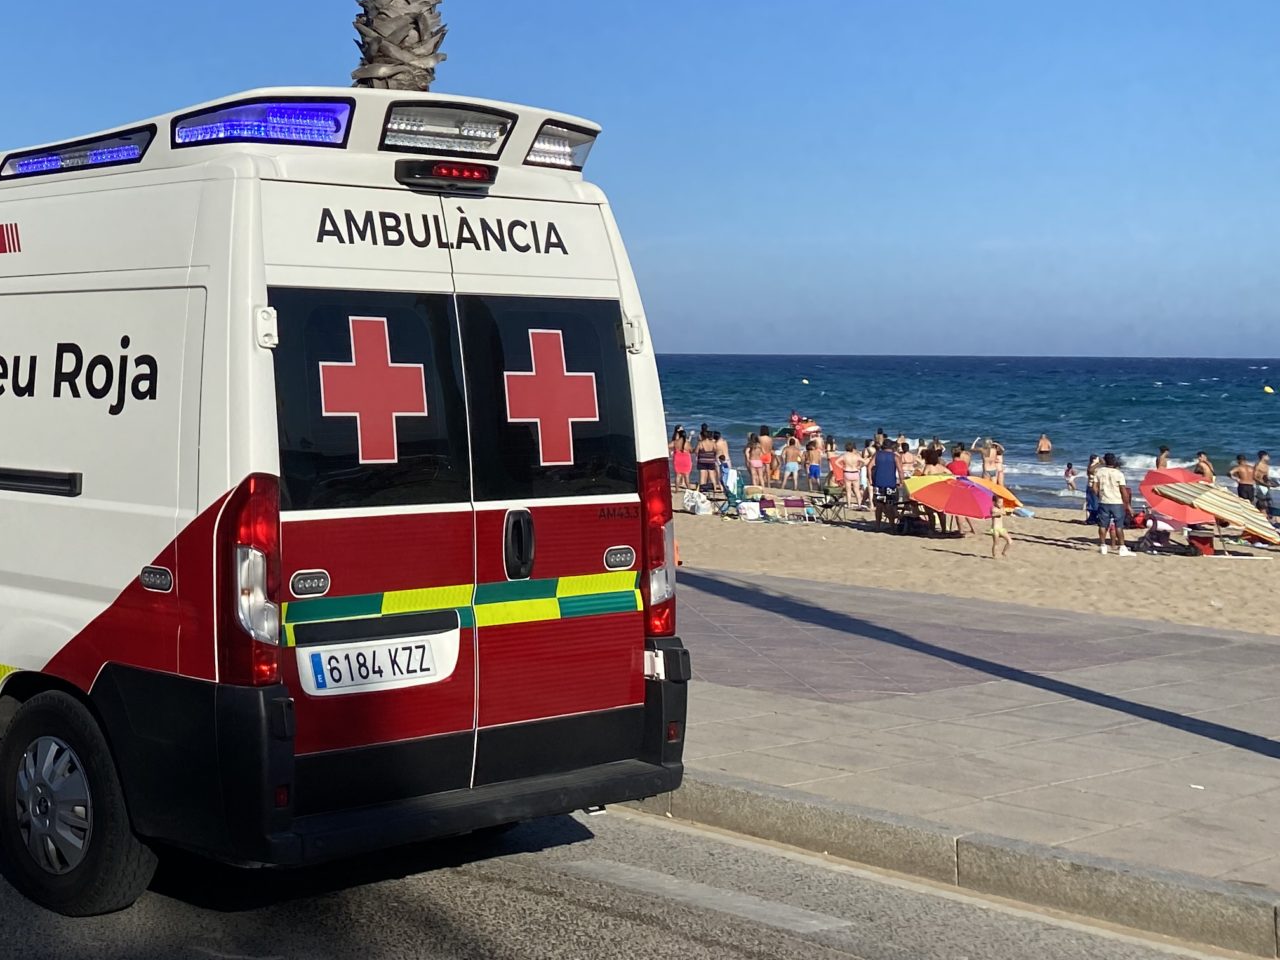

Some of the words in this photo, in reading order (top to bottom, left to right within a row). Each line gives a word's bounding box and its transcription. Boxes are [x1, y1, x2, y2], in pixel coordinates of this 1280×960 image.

[317, 206, 569, 255] AMBULÀNCIA
[53, 335, 158, 415] Roja
[327, 650, 384, 683] 6184
[388, 644, 431, 676] KZZ
